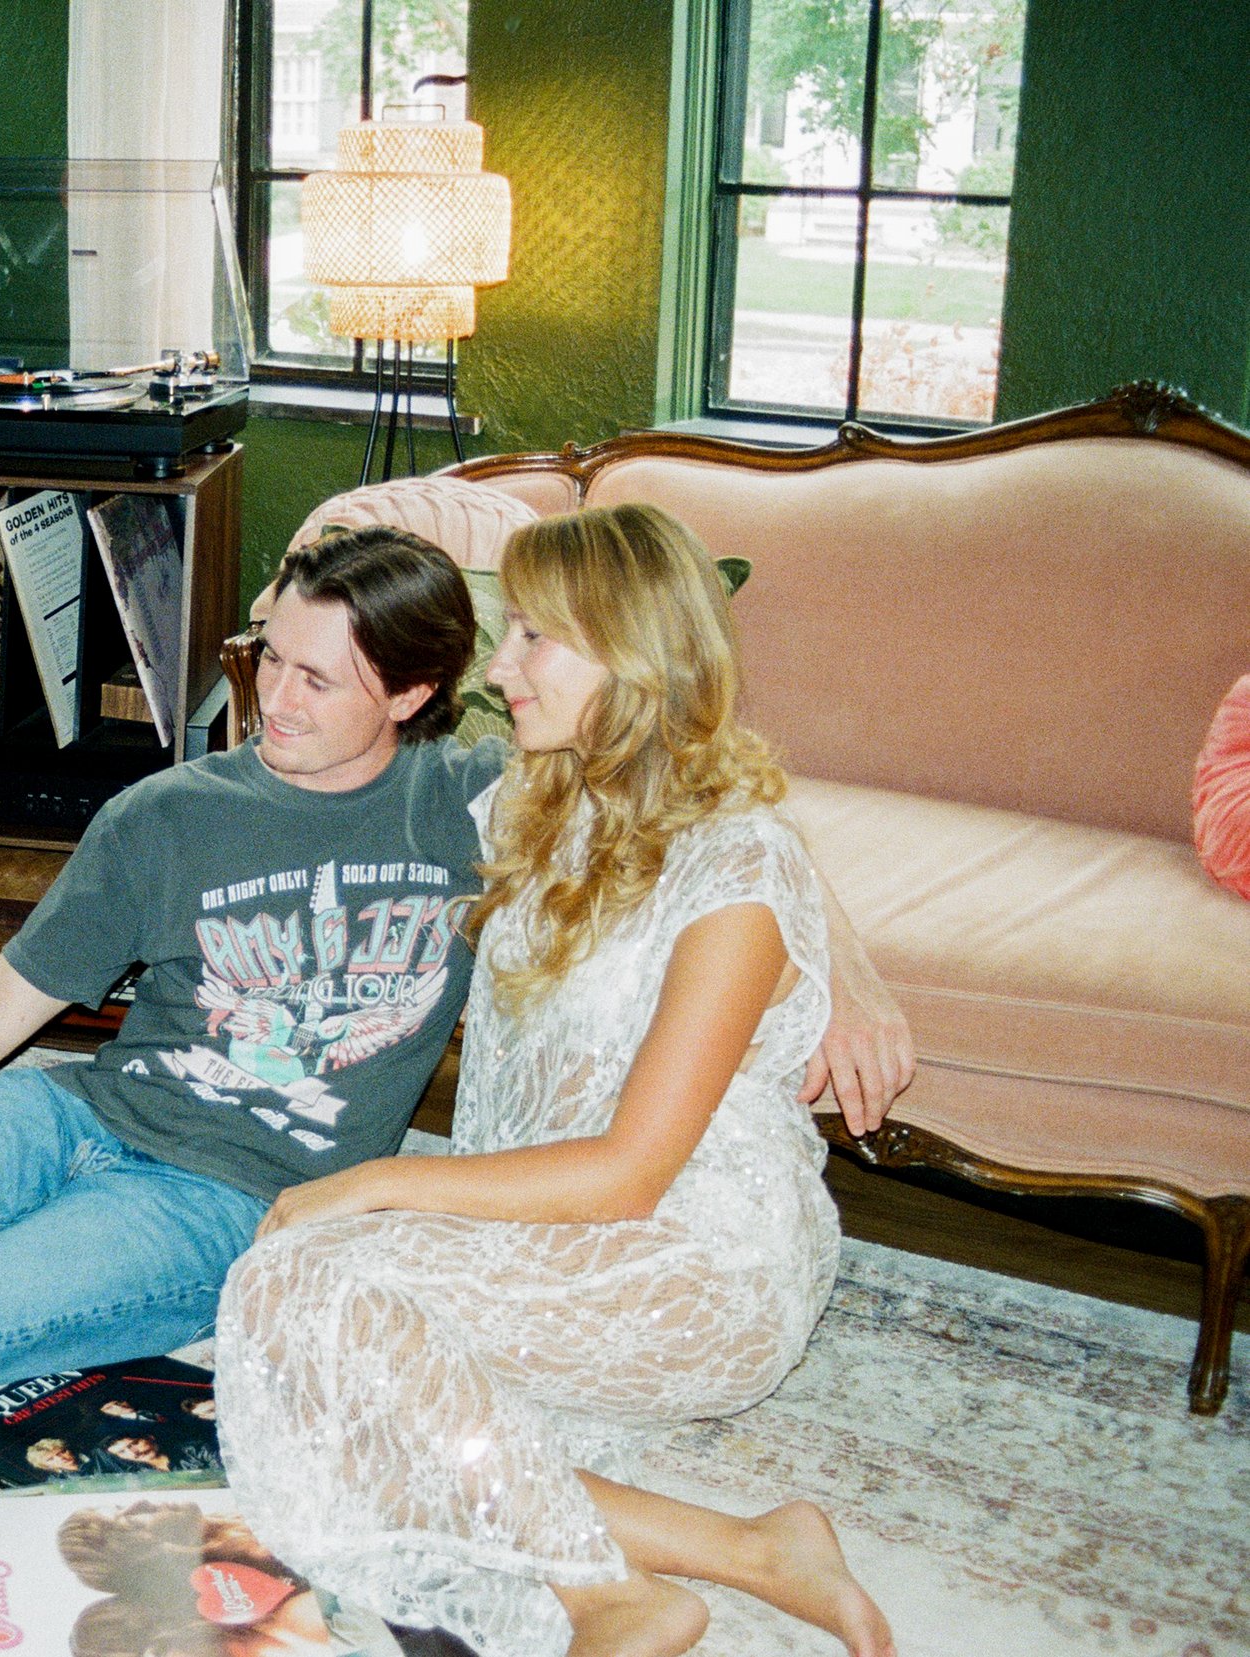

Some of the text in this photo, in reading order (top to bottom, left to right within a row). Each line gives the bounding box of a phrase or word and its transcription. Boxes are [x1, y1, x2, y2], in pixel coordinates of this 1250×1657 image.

[5, 491, 70, 532] GOLDEN HITS
[10, 506, 73, 545] of the 4 SEASONS
[201, 869, 308, 911] ONE NIGHT ONLY!
[342, 862, 449, 885] SOLD OUT SHOW!
[195, 909, 302, 988] AMY
[347, 895, 470, 974] JJ'S
[343, 973, 418, 1010] TOUR
[203, 1058, 234, 1086] THE
